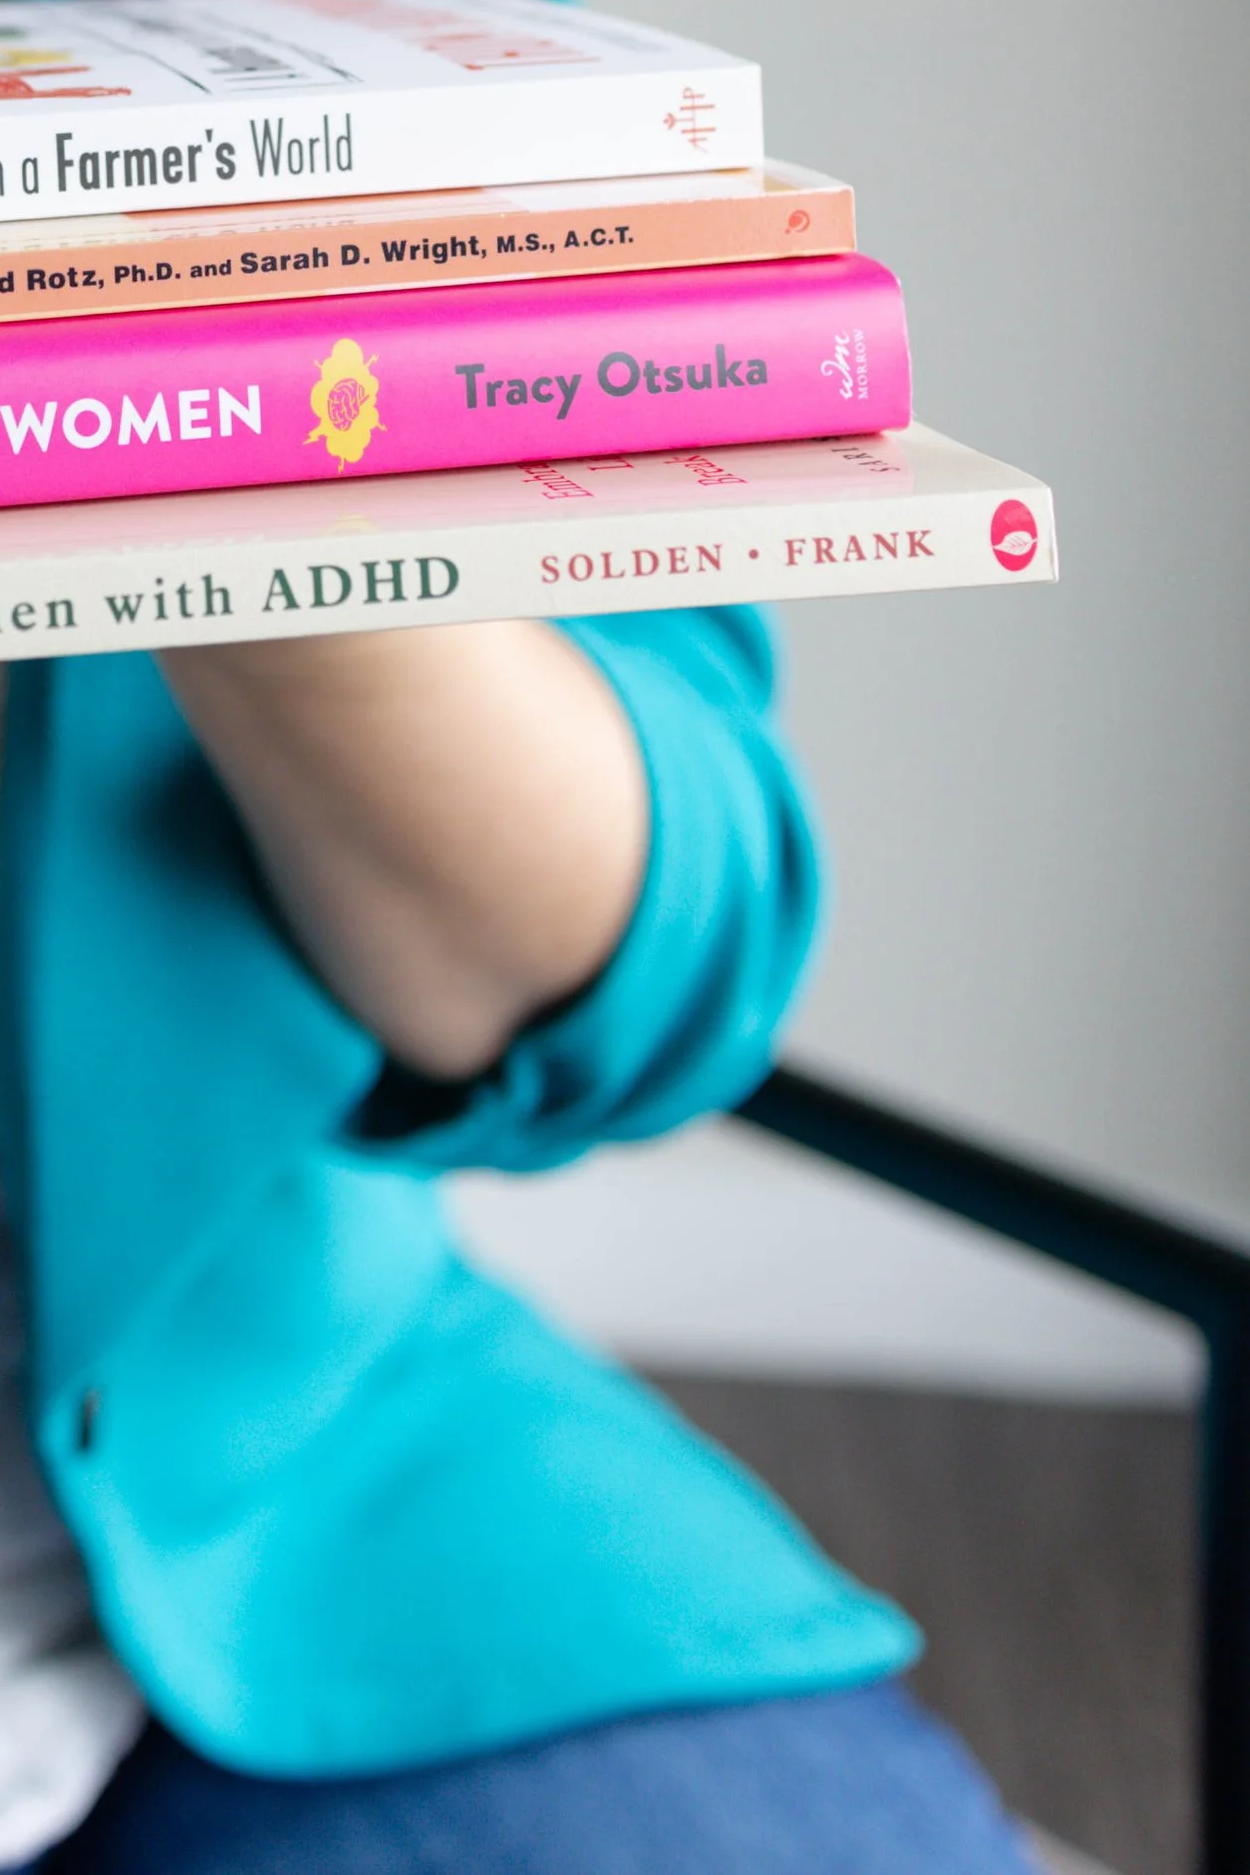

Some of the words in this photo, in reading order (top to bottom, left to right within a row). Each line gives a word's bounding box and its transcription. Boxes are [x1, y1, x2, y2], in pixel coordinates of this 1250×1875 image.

[22, 158, 39, 194] a
[56, 129, 235, 192] Farmer's
[250, 113, 352, 177] World
[27, 268, 104, 290] Rotz,
[114, 262, 181, 284] Ph.D.
[190, 259, 231, 278] and
[241, 247, 328, 273] Sarah
[341, 245, 369, 265] D.
[381, 236, 486, 264] Wright,
[497, 234, 556, 255] M.S.,
[564, 227, 634, 248] A.C.T.
[456, 364, 581, 420] Tracy
[597, 344, 767, 397] Otsuka
[854, 328, 869, 400] MORROW
[0, 385, 261, 454] WOMEN
[663, 454, 748, 487] Break
[106, 574, 232, 623] with
[263, 557, 459, 612] ADHD
[542, 545, 721, 583] SOLDEN
[785, 530, 934, 566] FRANK
